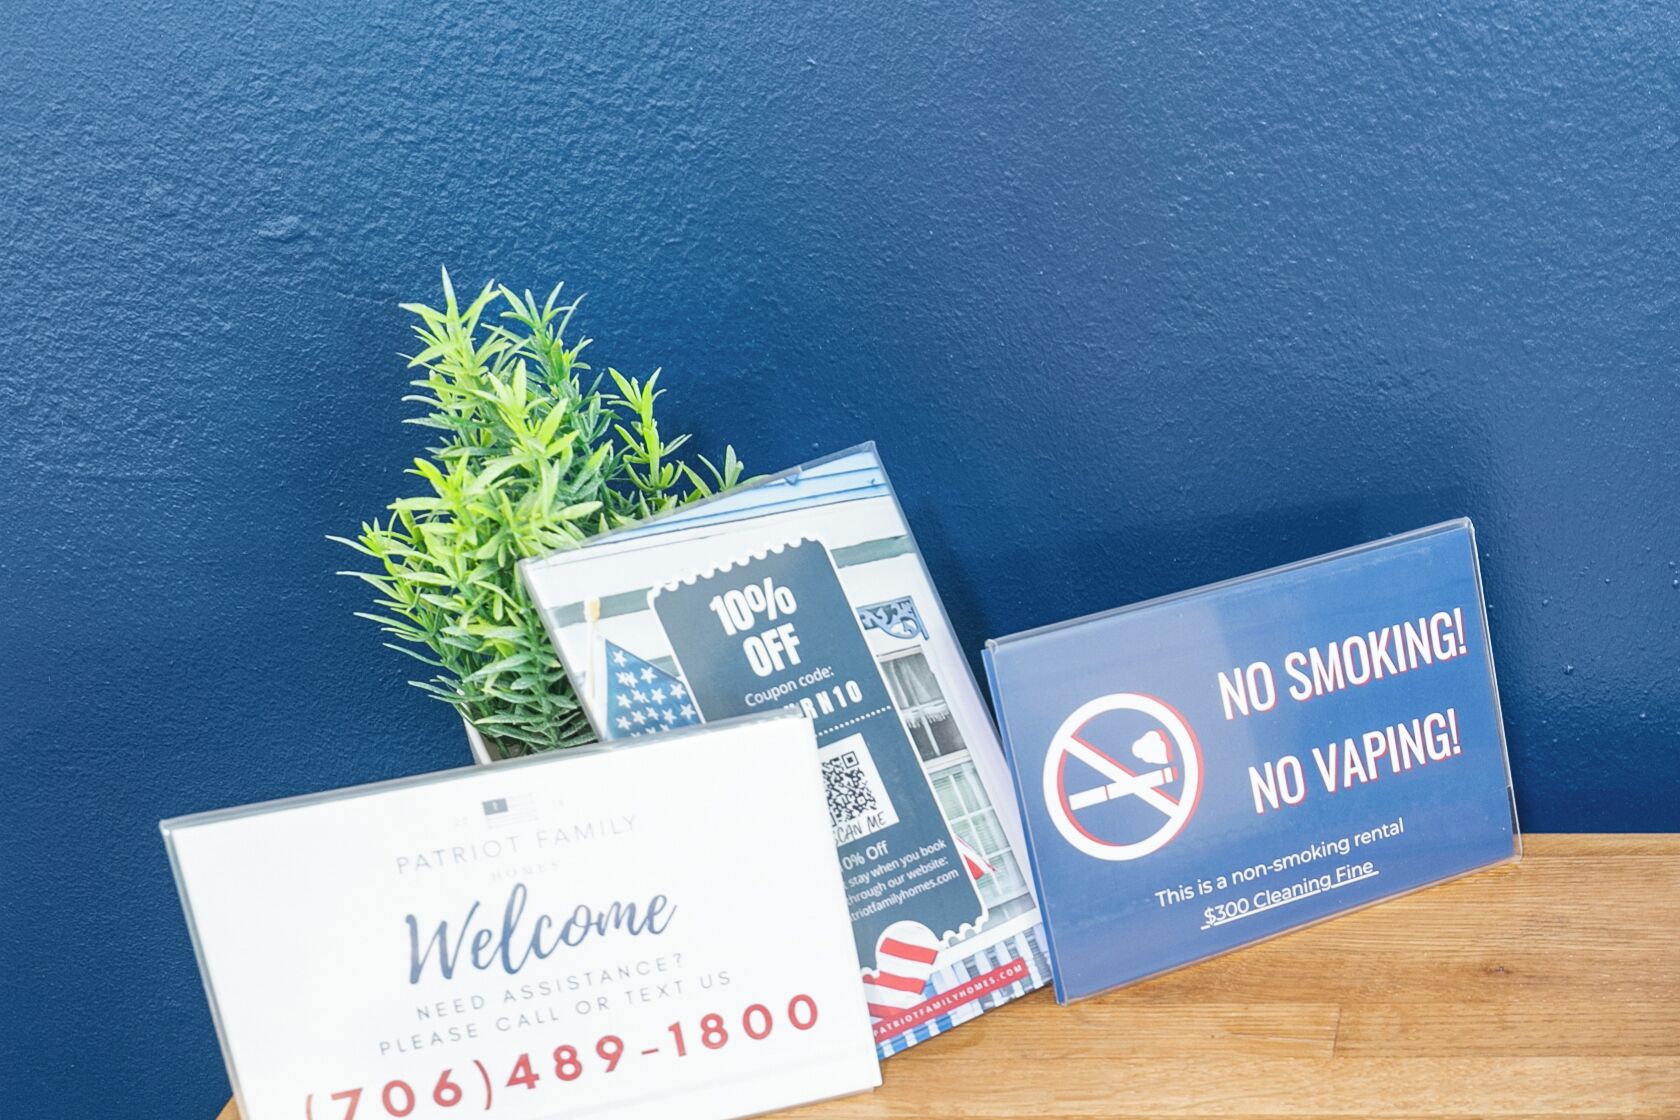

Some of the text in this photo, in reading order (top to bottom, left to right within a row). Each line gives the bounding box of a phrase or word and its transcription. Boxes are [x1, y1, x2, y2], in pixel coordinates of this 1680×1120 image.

[709, 577, 797, 636] 10%
[743, 623, 801, 677] OFF
[1217, 607, 1467, 720] NO SMOKING!
[744, 666, 835, 706] Coupon code:
[784, 680, 863, 719] RN10
[1248, 708, 1461, 814] NO VAPING!
[396, 815, 637, 874] PATRIOT FAMILY
[834, 811, 887, 846] CAN ME
[842, 840, 889, 870] 0% Off
[848, 839, 947, 887] stay when you book
[887, 875, 905, 888] our
[906, 856, 949, 880] website:
[1154, 817, 1404, 908] This is a non-smoking rental
[851, 869, 960, 921] triotfamilyhomes.com
[1204, 860, 1374, 926] $300 Cleaning Fine
[405, 883, 677, 984] Welcome
[379, 970, 731, 1056] PLEASE CALL OR TEXT US
[418, 953, 683, 1021] NEED ASSISTANCE?
[873, 964, 1023, 1037] PATRIOTFAMILYHOMES.COM
